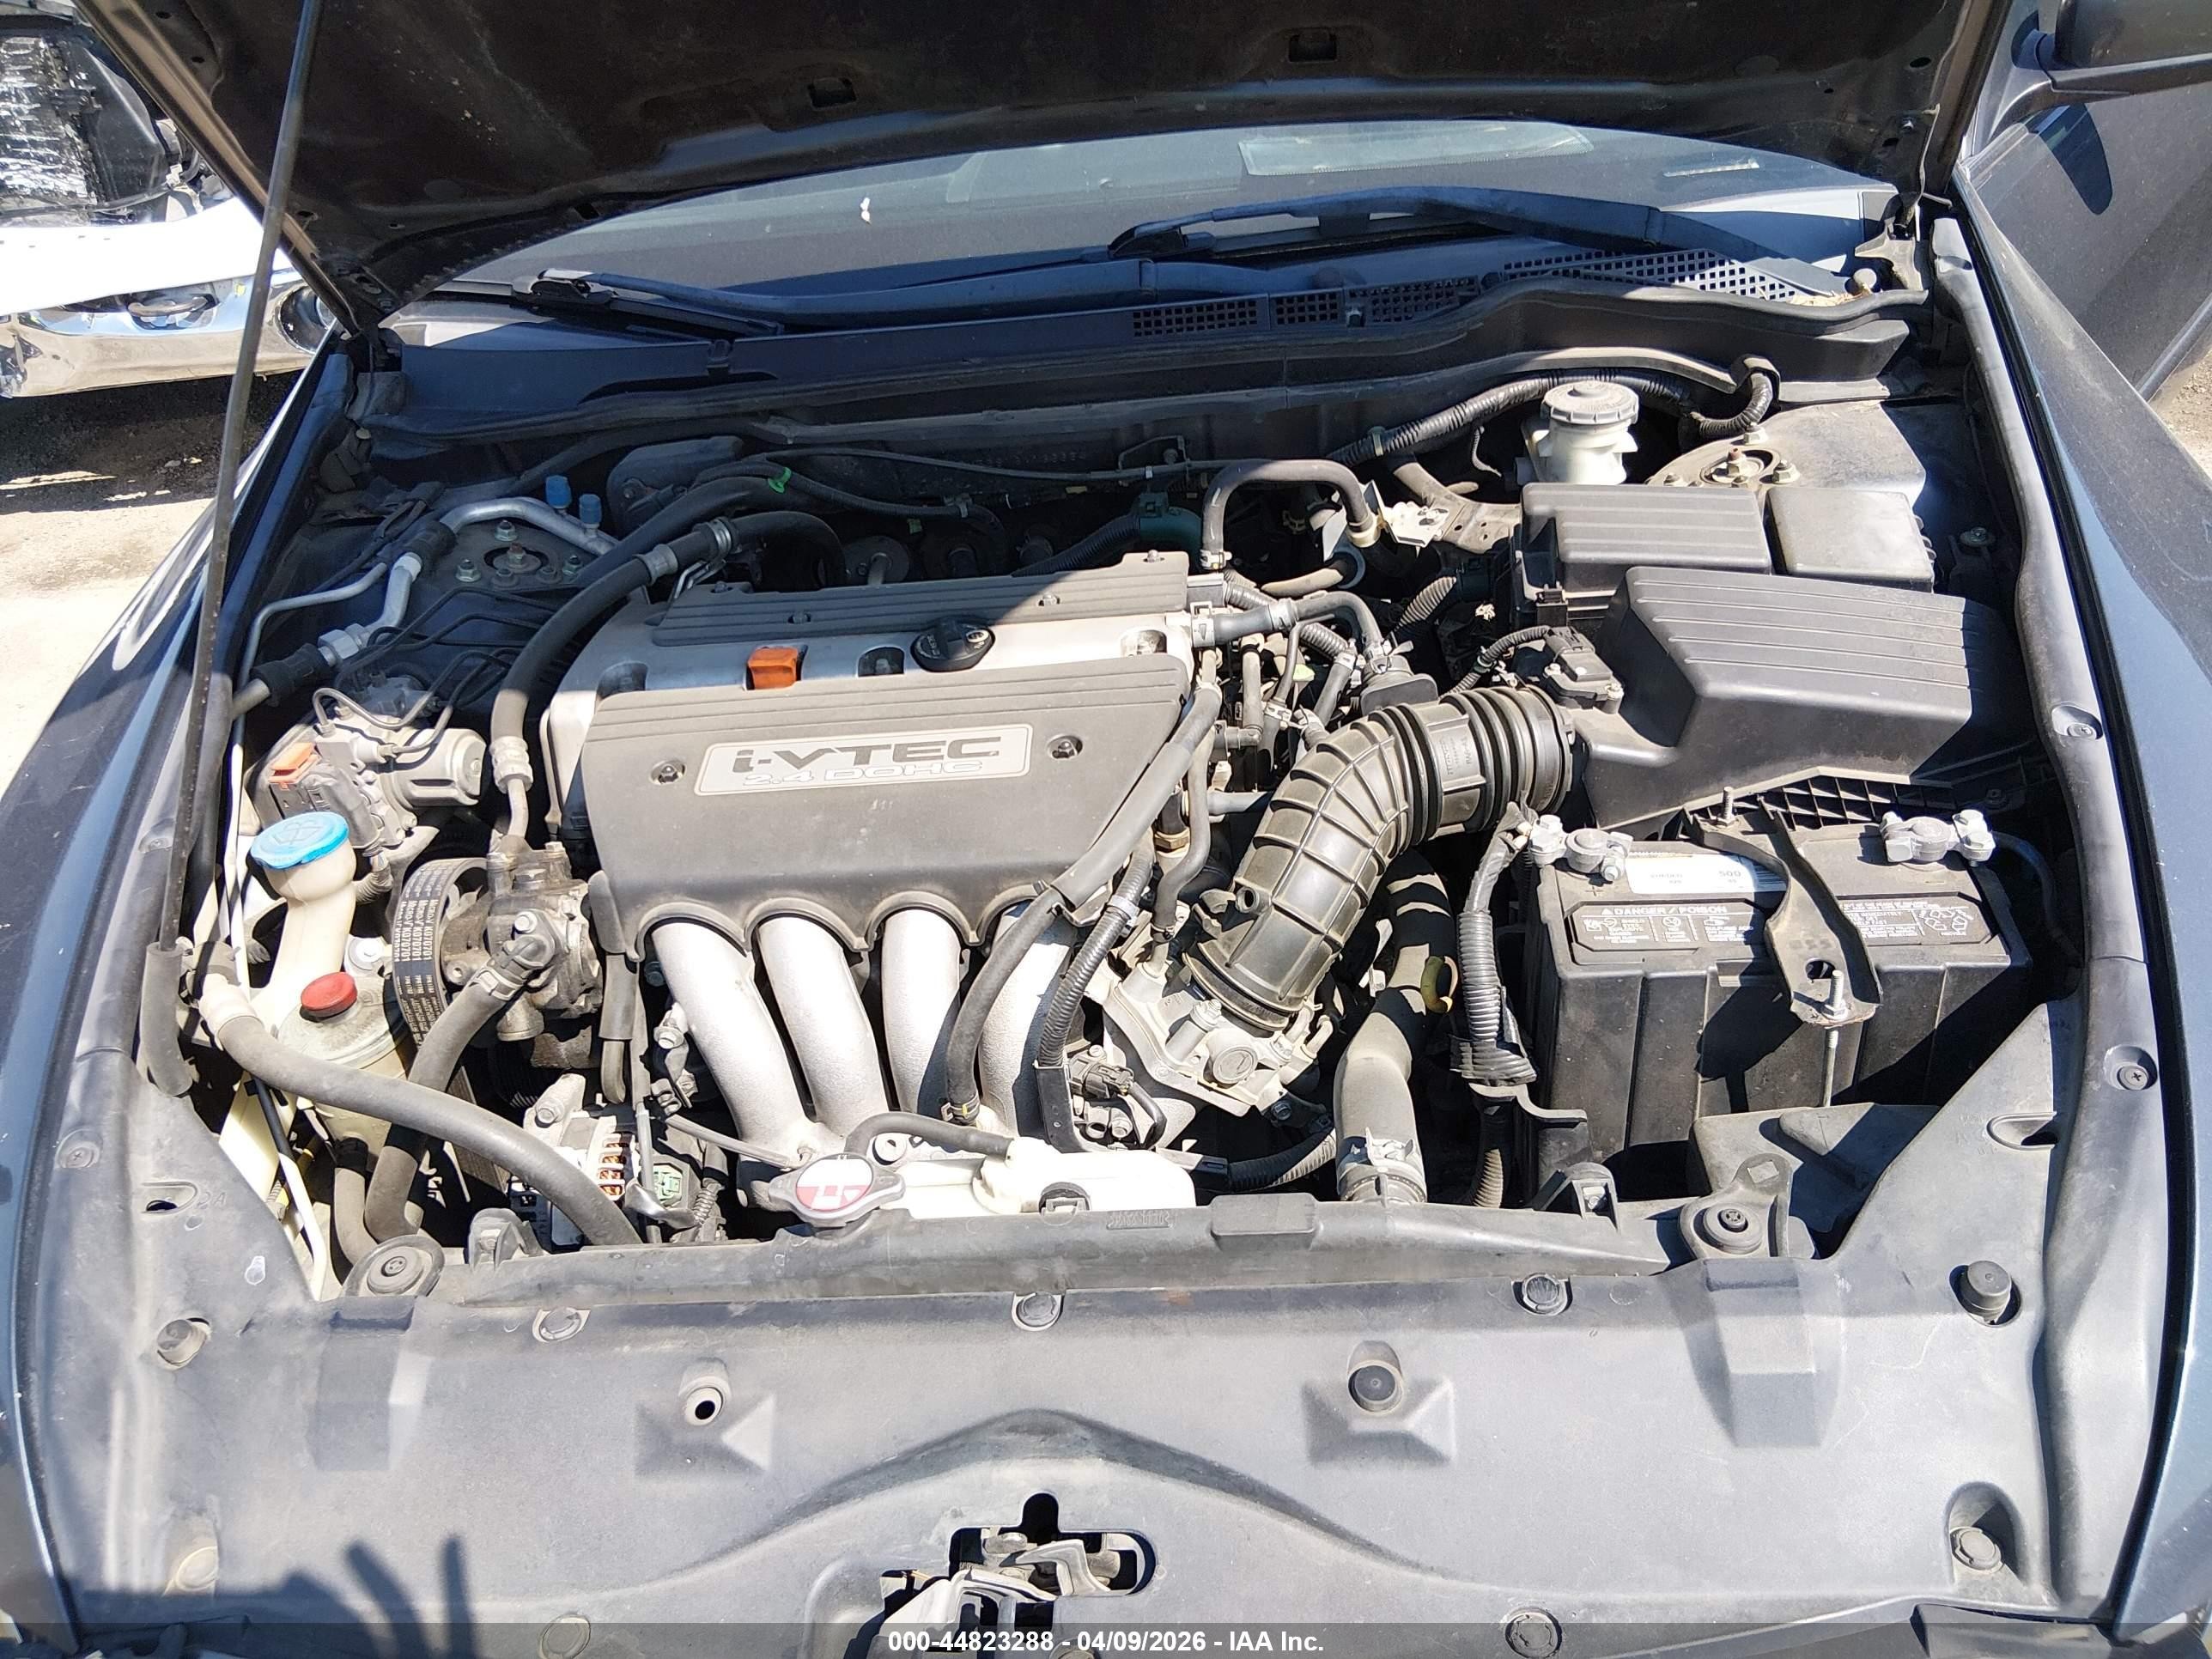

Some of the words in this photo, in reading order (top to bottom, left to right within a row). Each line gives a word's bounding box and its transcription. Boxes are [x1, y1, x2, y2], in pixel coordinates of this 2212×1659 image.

[732, 736, 1001, 773] i-VTEC
[743, 770, 814, 786] 2.4
[823, 760, 983, 781] DOHC
[1613, 906, 1667, 915] DANGER
[1680, 906, 1728, 915] POISON
[401, 927, 411, 963] K070701
[412, 927, 423, 962] K070701
[422, 926, 434, 961] K070701
